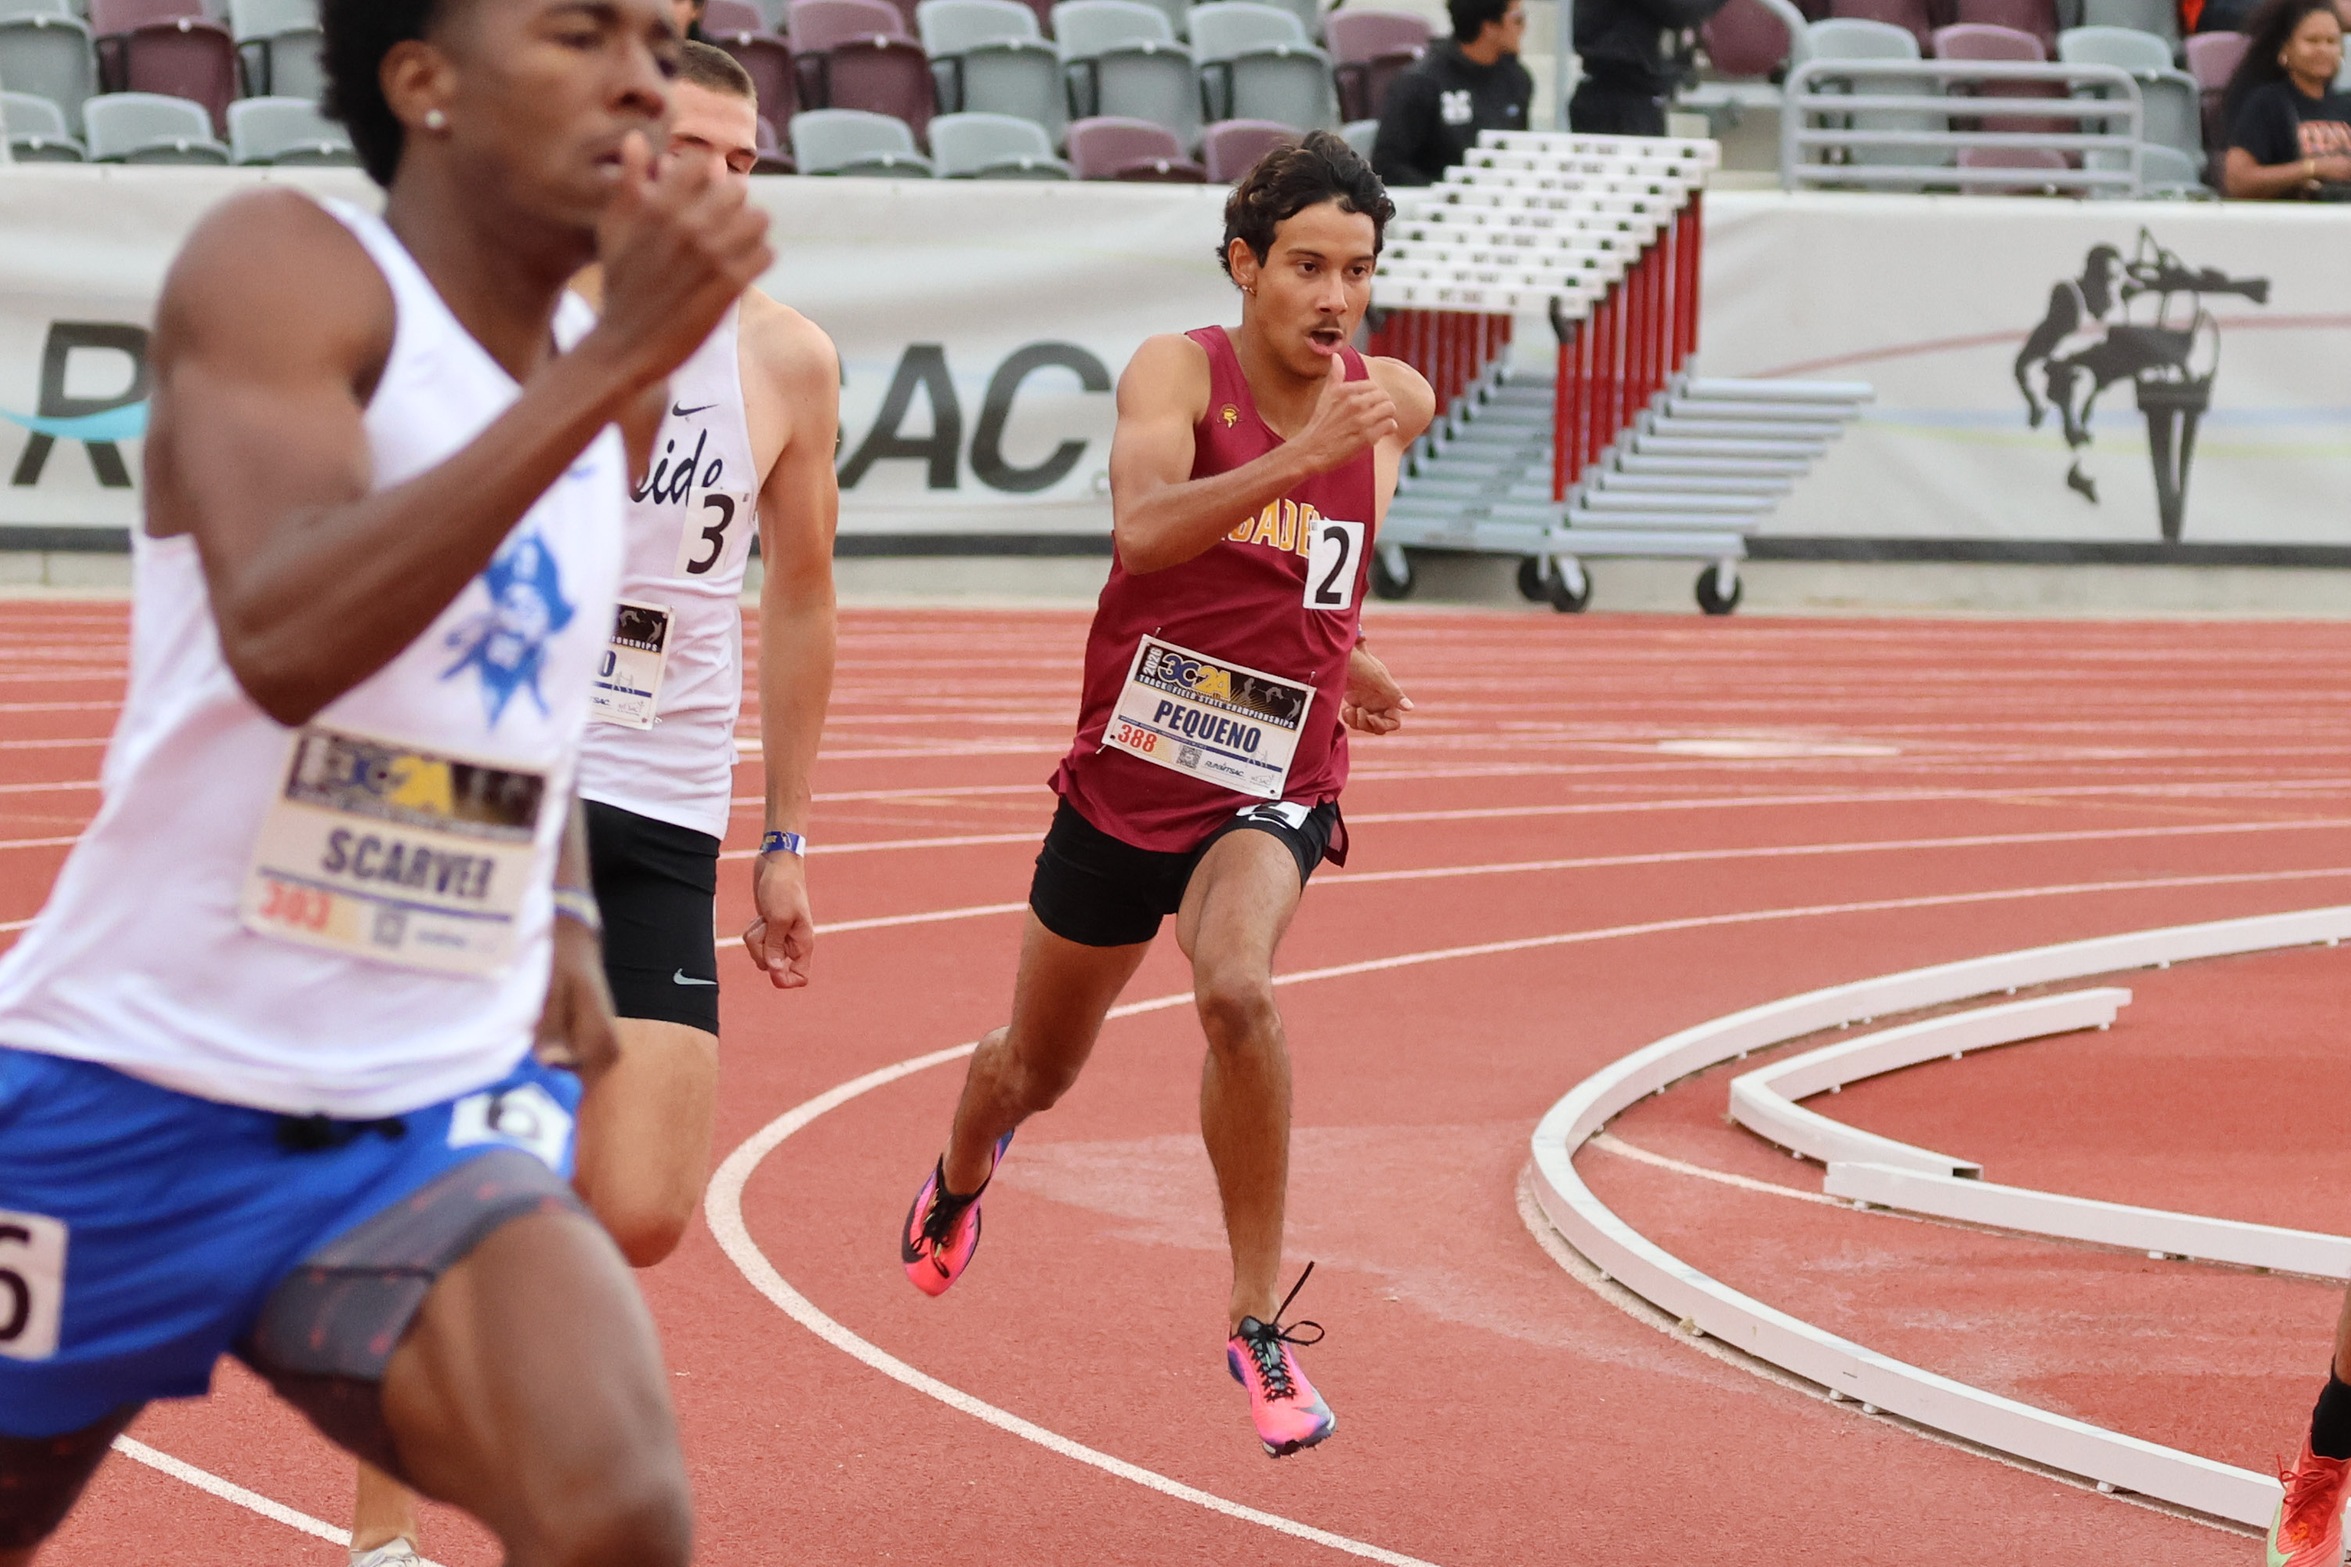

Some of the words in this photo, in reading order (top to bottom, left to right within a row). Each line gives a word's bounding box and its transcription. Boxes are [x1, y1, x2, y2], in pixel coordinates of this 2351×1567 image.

[686, 494, 735, 575] 3
[1315, 526, 1350, 605] 2
[1139, 674, 1168, 690] TRACK
[1226, 702, 1295, 729] CHAMPIONSHIPS
[1157, 652, 1231, 702] 3C2A
[1117, 724, 1158, 753] 388
[1153, 699, 1262, 753] PEQUENO
[321, 829, 495, 901] SCARVER
